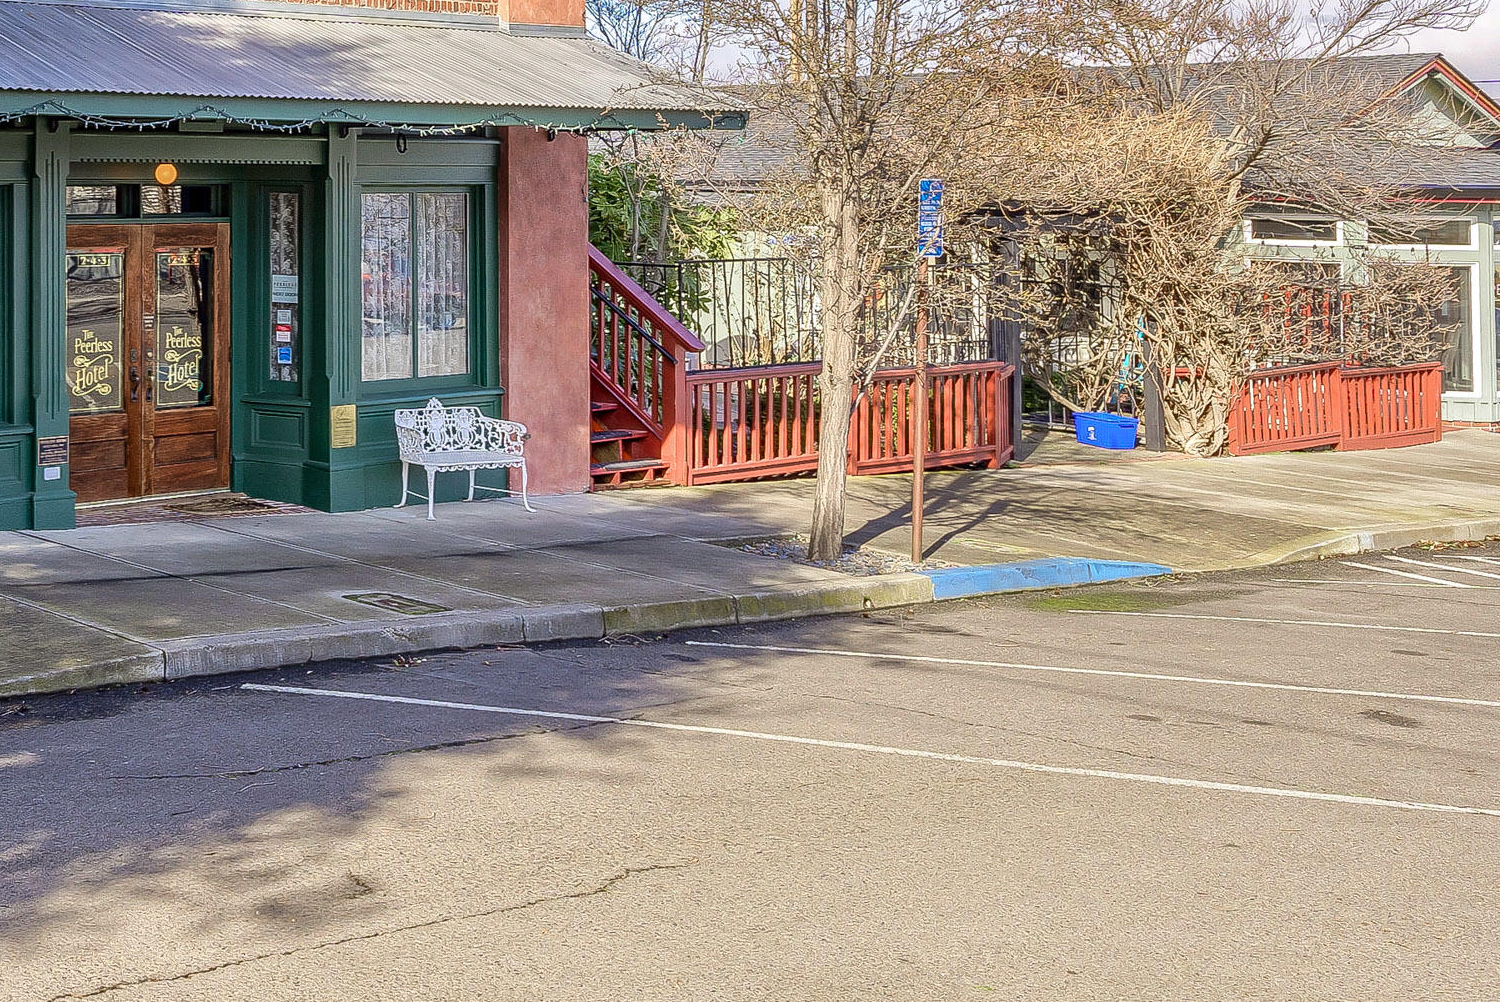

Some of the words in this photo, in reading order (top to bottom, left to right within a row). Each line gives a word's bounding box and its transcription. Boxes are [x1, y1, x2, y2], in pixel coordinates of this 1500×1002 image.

[74, 337, 113, 354] Peerless
[165, 332, 202, 349] Peerless
[75, 359, 109, 390] Hotel
[167, 354, 200, 386] Hotel
